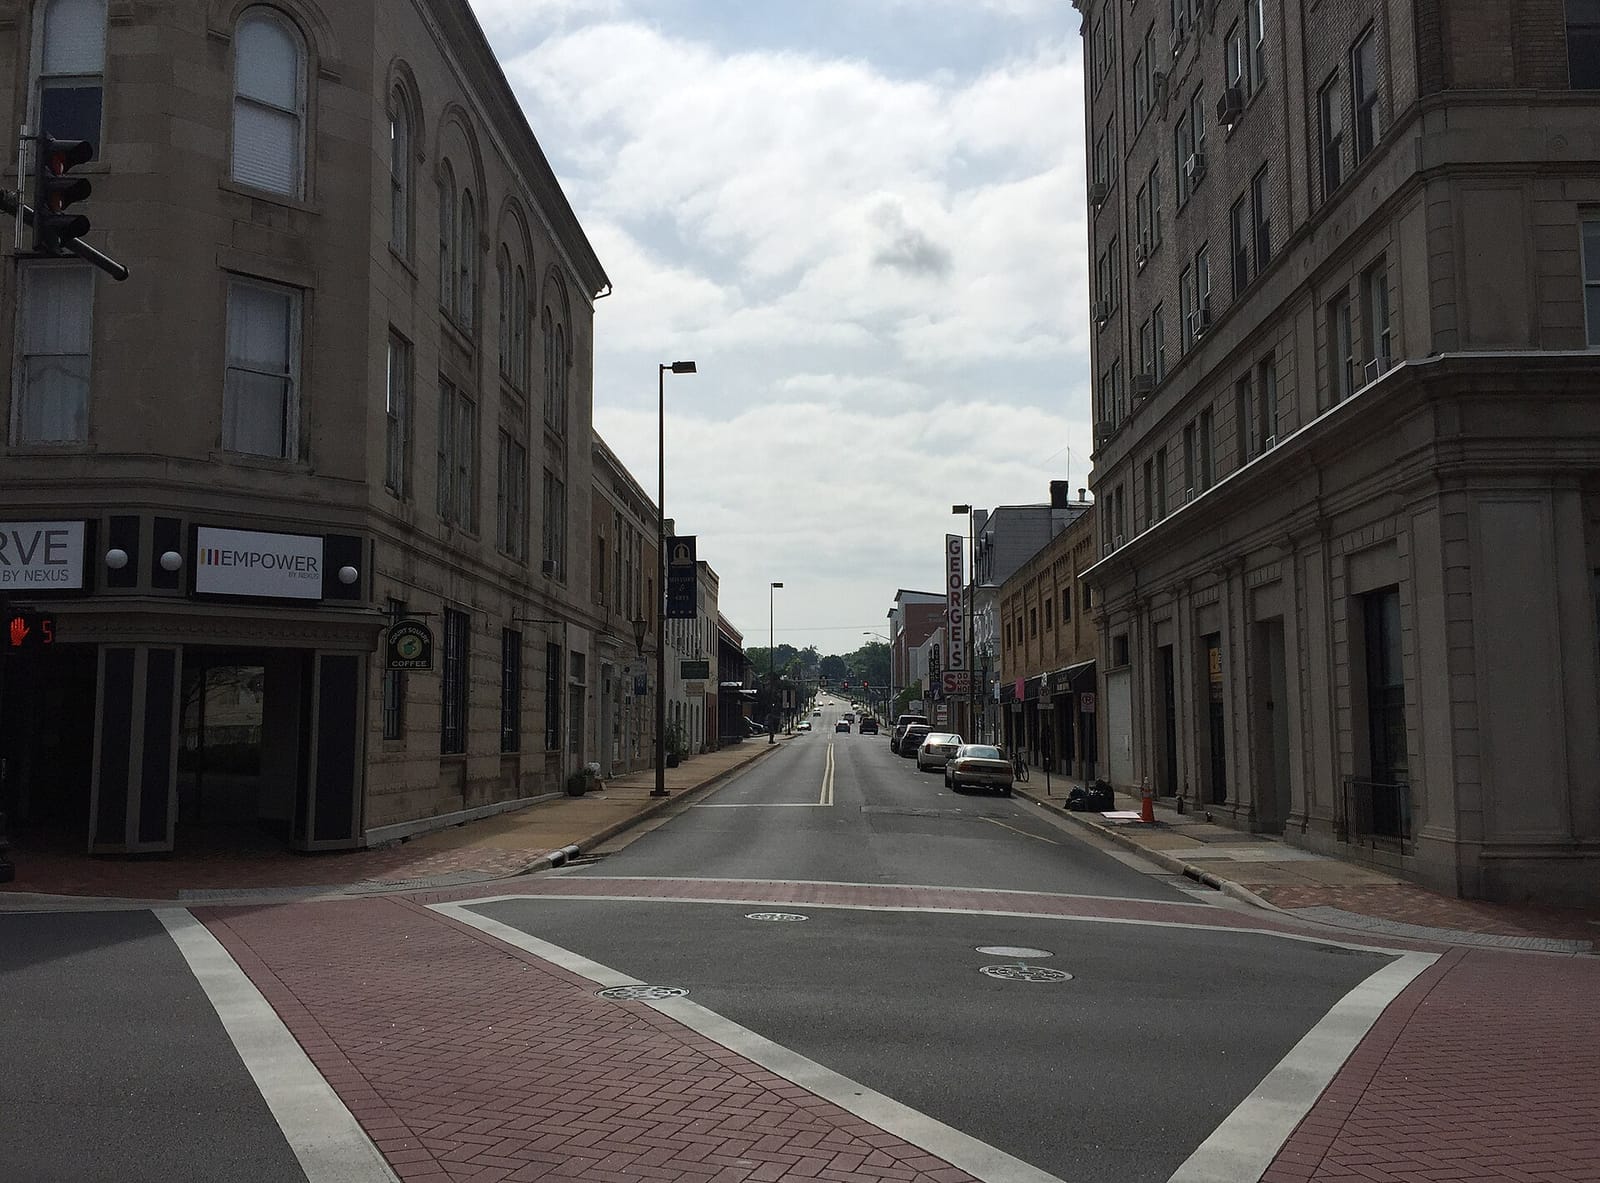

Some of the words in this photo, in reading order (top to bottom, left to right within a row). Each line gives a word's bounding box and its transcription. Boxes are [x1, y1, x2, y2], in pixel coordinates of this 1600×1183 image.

[221, 550, 318, 572] EMPOWER
[2, 569, 20, 582] BY
[24, 569, 70, 582] NEXUS
[42, 620, 53, 644] 5
[390, 627, 408, 645] COURT
[408, 626, 430, 645] SQUARE
[391, 660, 428, 668] COFFEE
